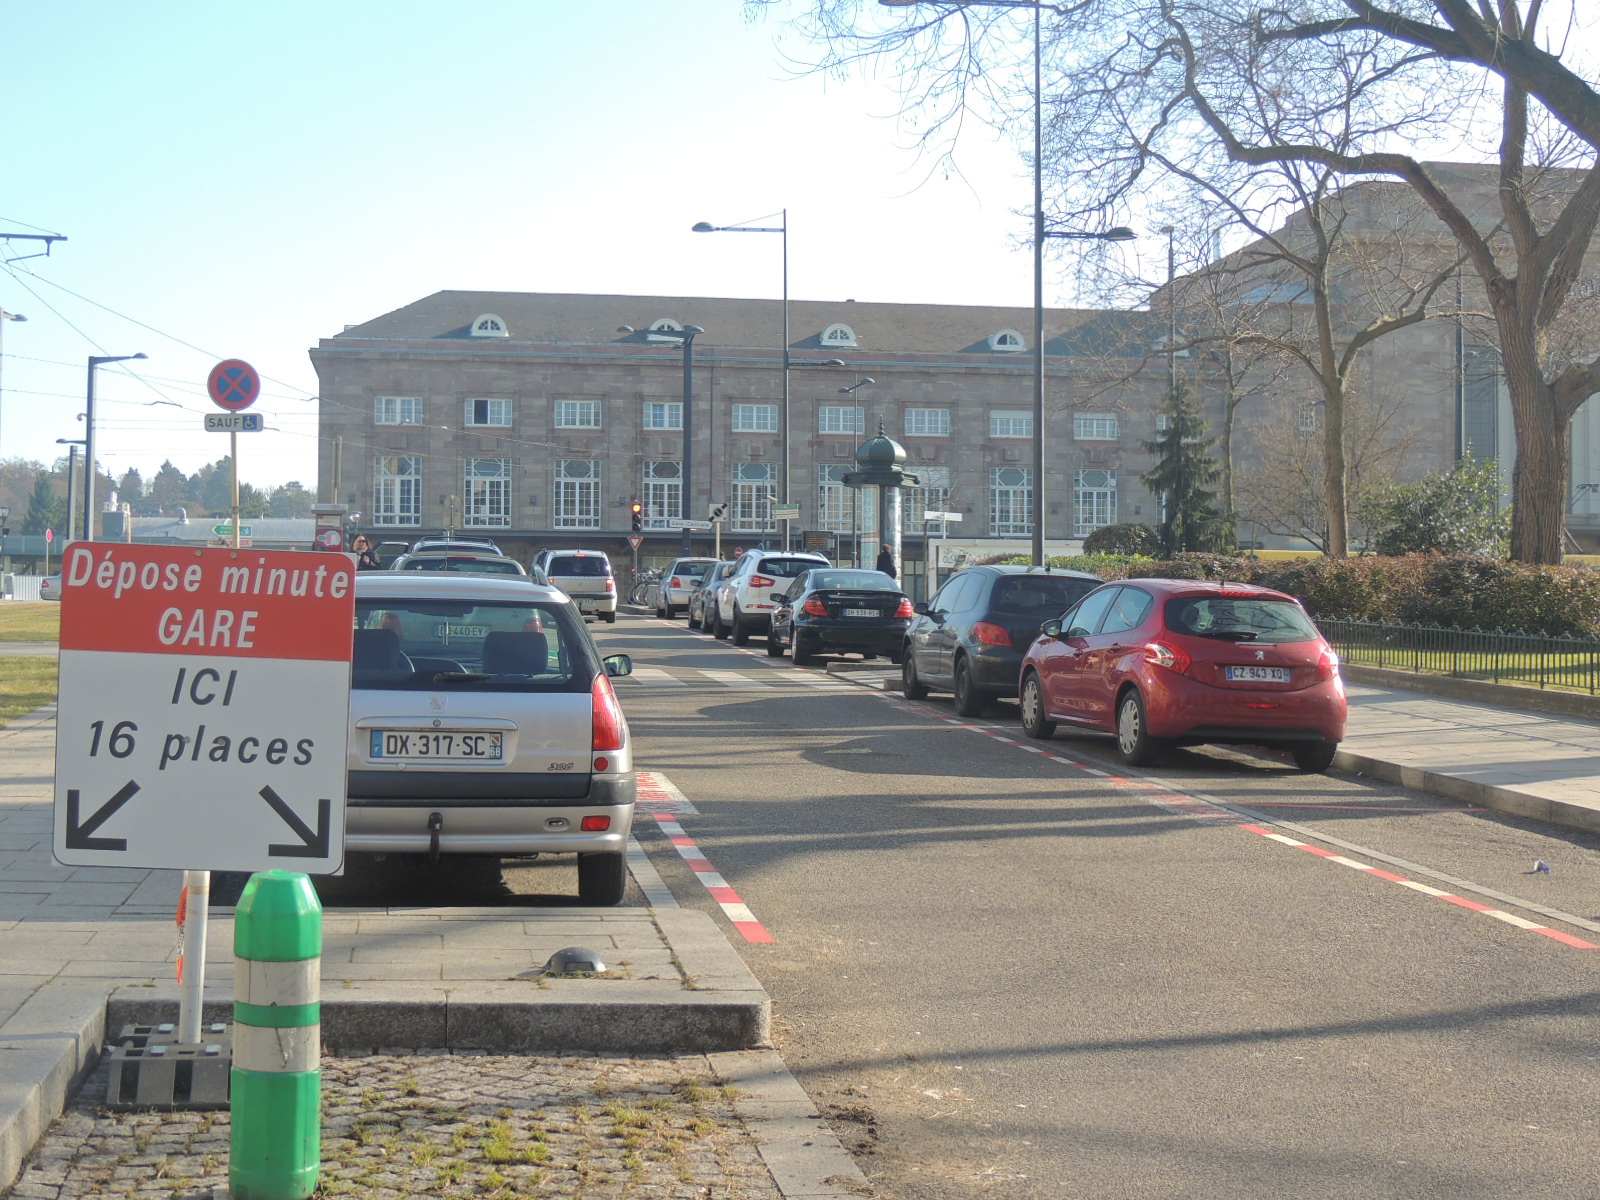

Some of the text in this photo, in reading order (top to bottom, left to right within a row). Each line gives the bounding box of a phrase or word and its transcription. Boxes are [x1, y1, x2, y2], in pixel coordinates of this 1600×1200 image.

[208, 417, 240, 428] SAUF
[68, 549, 349, 599] Dépose minute
[158, 607, 259, 648] GARE
[171, 667, 238, 706] ICI
[89, 720, 314, 770] 16 places
[386, 734, 486, 756] DX-317-SC
